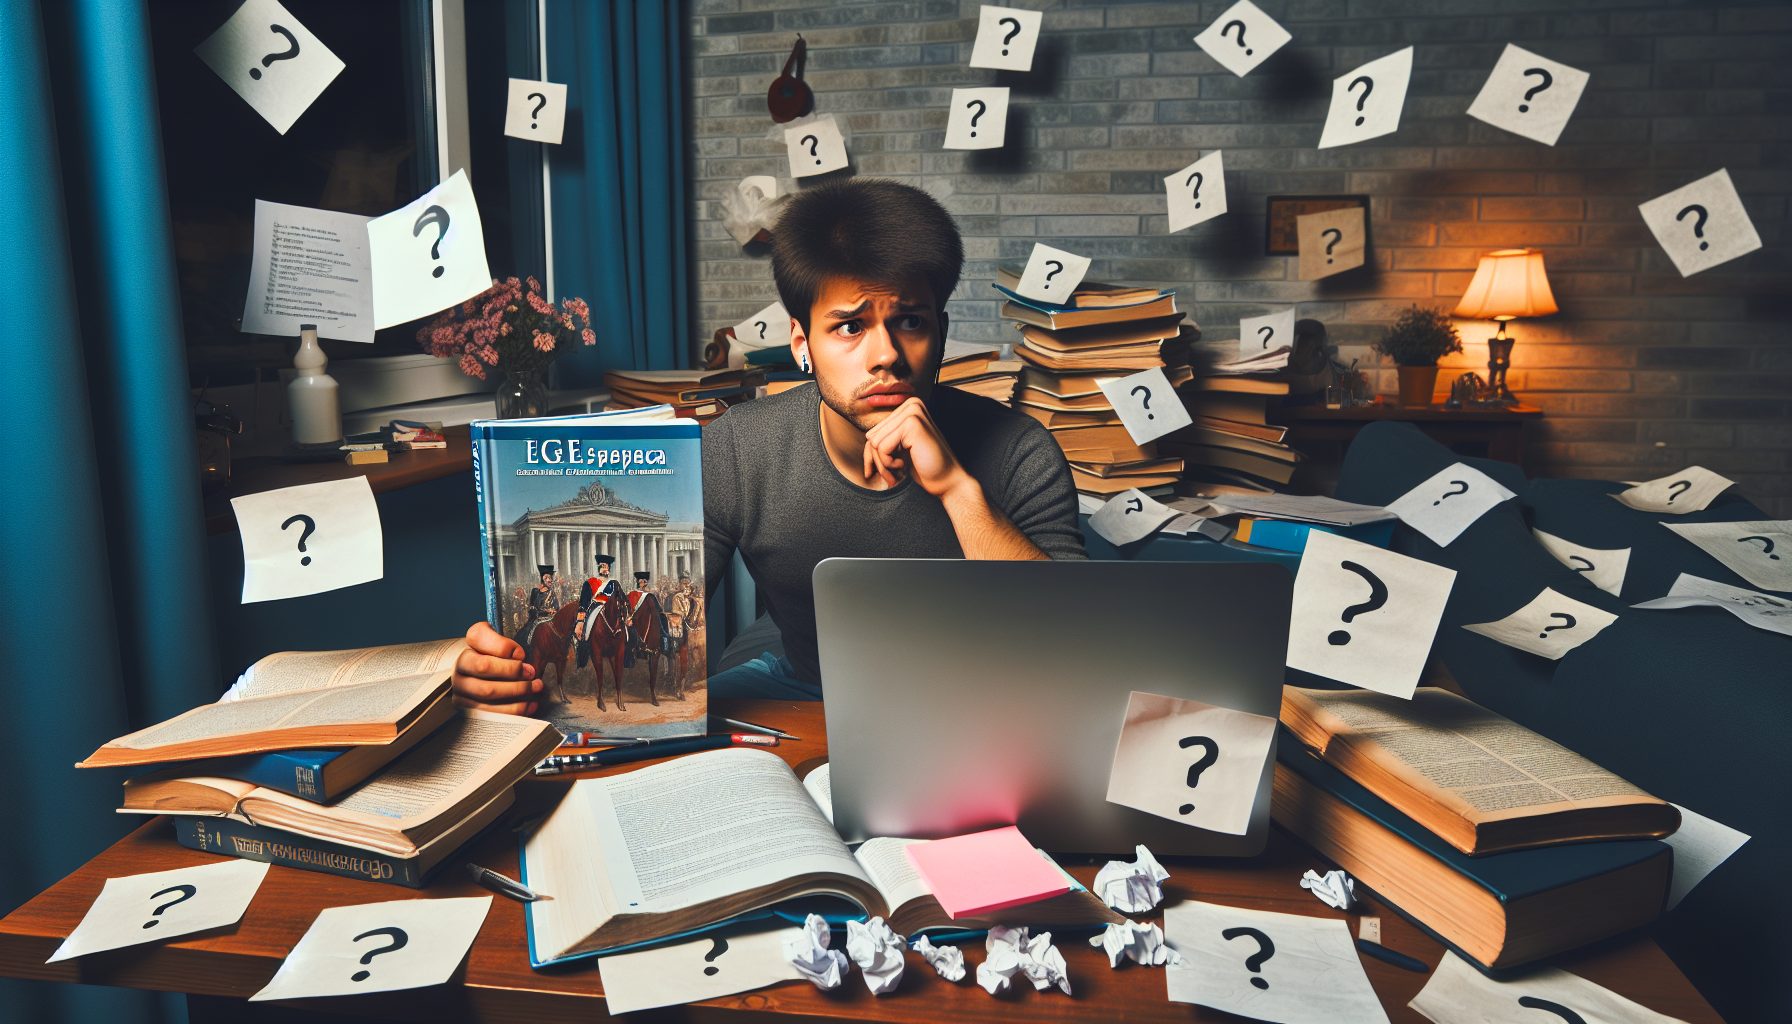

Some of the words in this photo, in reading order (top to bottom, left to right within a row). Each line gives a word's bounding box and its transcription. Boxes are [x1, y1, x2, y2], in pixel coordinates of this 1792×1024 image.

[250, 22, 302, 80] ?
[999, 18, 1021, 56] ?
[1221, 20, 1252, 56] ?
[1347, 75, 1373, 126] ?
[1519, 68, 1552, 113] ?
[528, 93, 546, 129] ?
[967, 100, 986, 137] ?
[801, 135, 821, 165] ?
[1186, 172, 1203, 208] ?
[413, 204, 450, 278] ?
[1322, 228, 1342, 264] ?
[1676, 204, 1708, 251] ?
[1044, 261, 1063, 289] ?
[1258, 326, 1275, 349] ?
[1131, 386, 1154, 420] ?
[1433, 480, 1468, 506] ?
[1667, 481, 1691, 505] ?
[281, 514, 315, 566] ?
[1738, 536, 1779, 560] ?
[1328, 561, 1388, 645] ?
[1540, 613, 1576, 638] ?
[1179, 736, 1219, 815] ?
[143, 885, 198, 929] ?
[351, 927, 408, 982] ?
[704, 936, 729, 976] ?
[1222, 927, 1275, 990] ?
